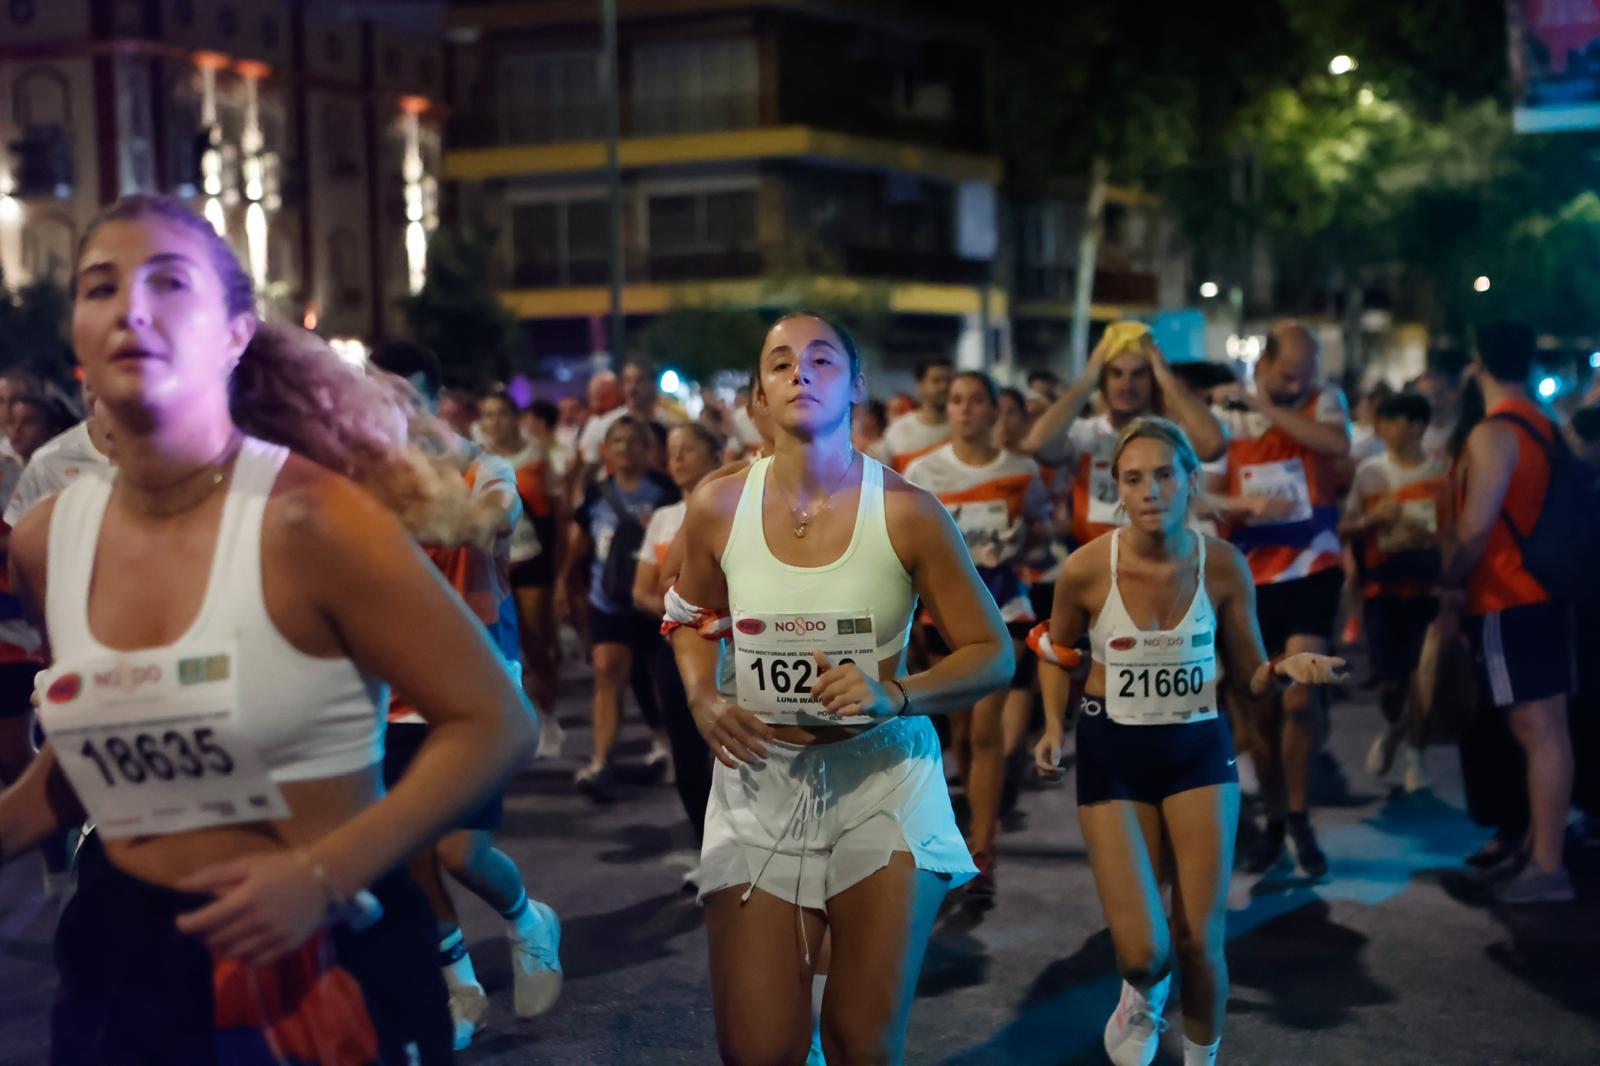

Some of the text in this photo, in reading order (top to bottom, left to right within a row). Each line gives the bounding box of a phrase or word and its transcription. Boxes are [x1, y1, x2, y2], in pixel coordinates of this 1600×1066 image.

[750, 657, 856, 694] 162
[1119, 666, 1203, 698] 21660
[81, 728, 234, 787] 18635
